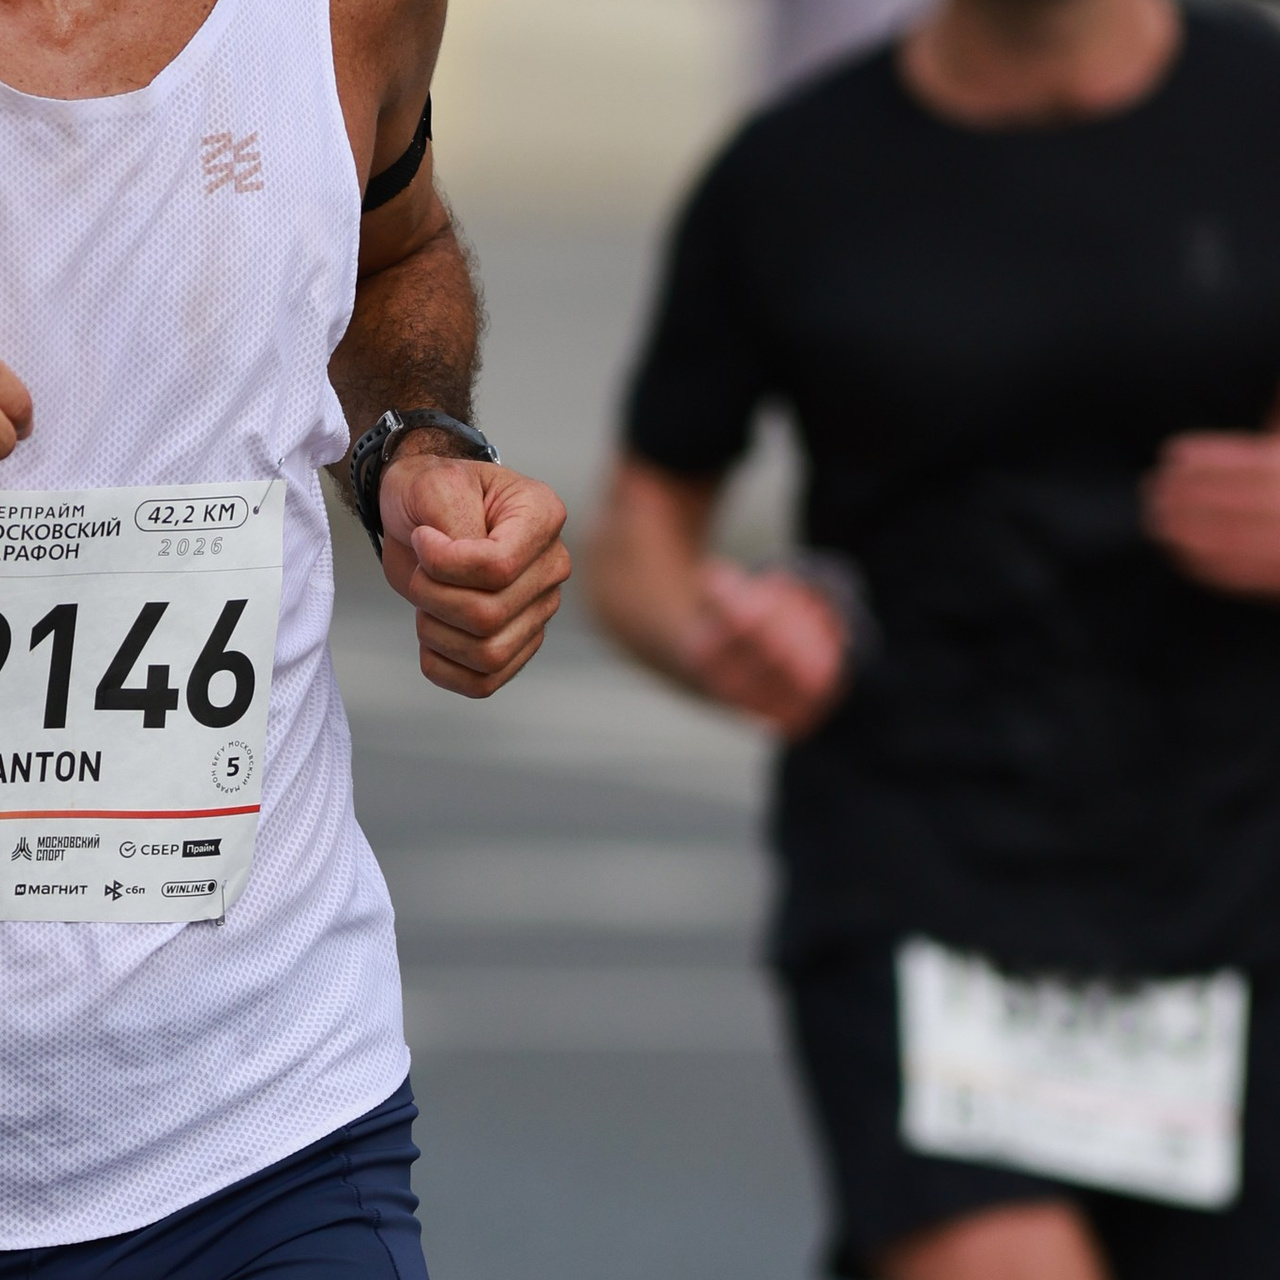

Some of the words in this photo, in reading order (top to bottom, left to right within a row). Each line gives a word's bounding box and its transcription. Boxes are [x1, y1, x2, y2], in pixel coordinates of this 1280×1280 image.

[147, 505, 195, 527] 42,2
[158, 537, 224, 557] 2026
[226, 756, 240, 777] 5
[36, 834, 100, 849] МОСКОВСКИЙ
[36, 849, 66, 861] СПОРТ
[140, 844, 180, 856] СБЕР
[186, 843, 215, 854] Прайм
[166, 883, 207, 894] WINLINE
